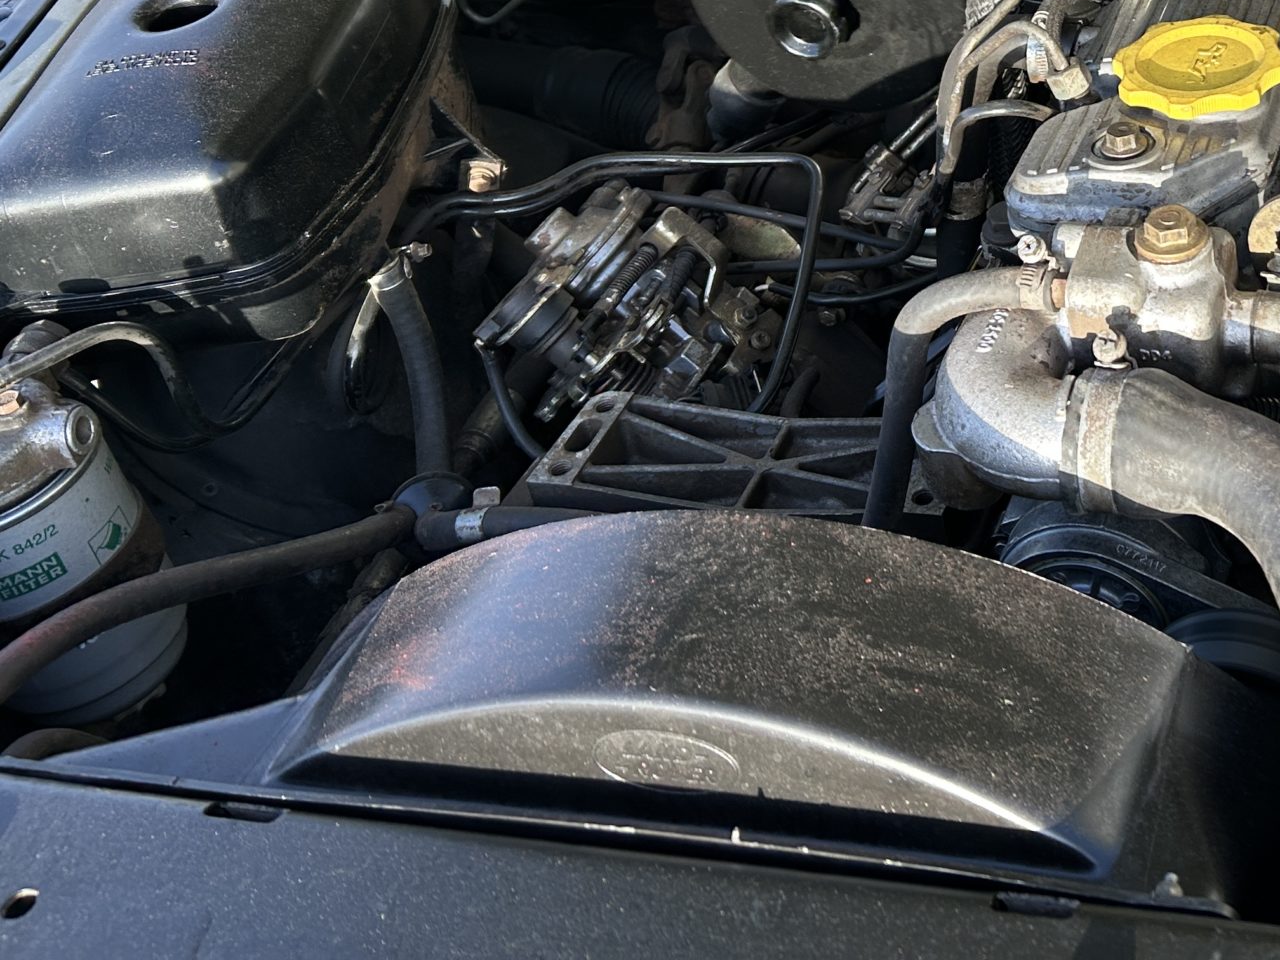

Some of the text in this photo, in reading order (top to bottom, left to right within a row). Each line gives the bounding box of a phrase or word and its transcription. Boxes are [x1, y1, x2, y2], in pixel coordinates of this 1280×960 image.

[12, 524, 59, 555] 842/2
[0, 556, 58, 589] MANN
[1, 566, 63, 599] FILTER
